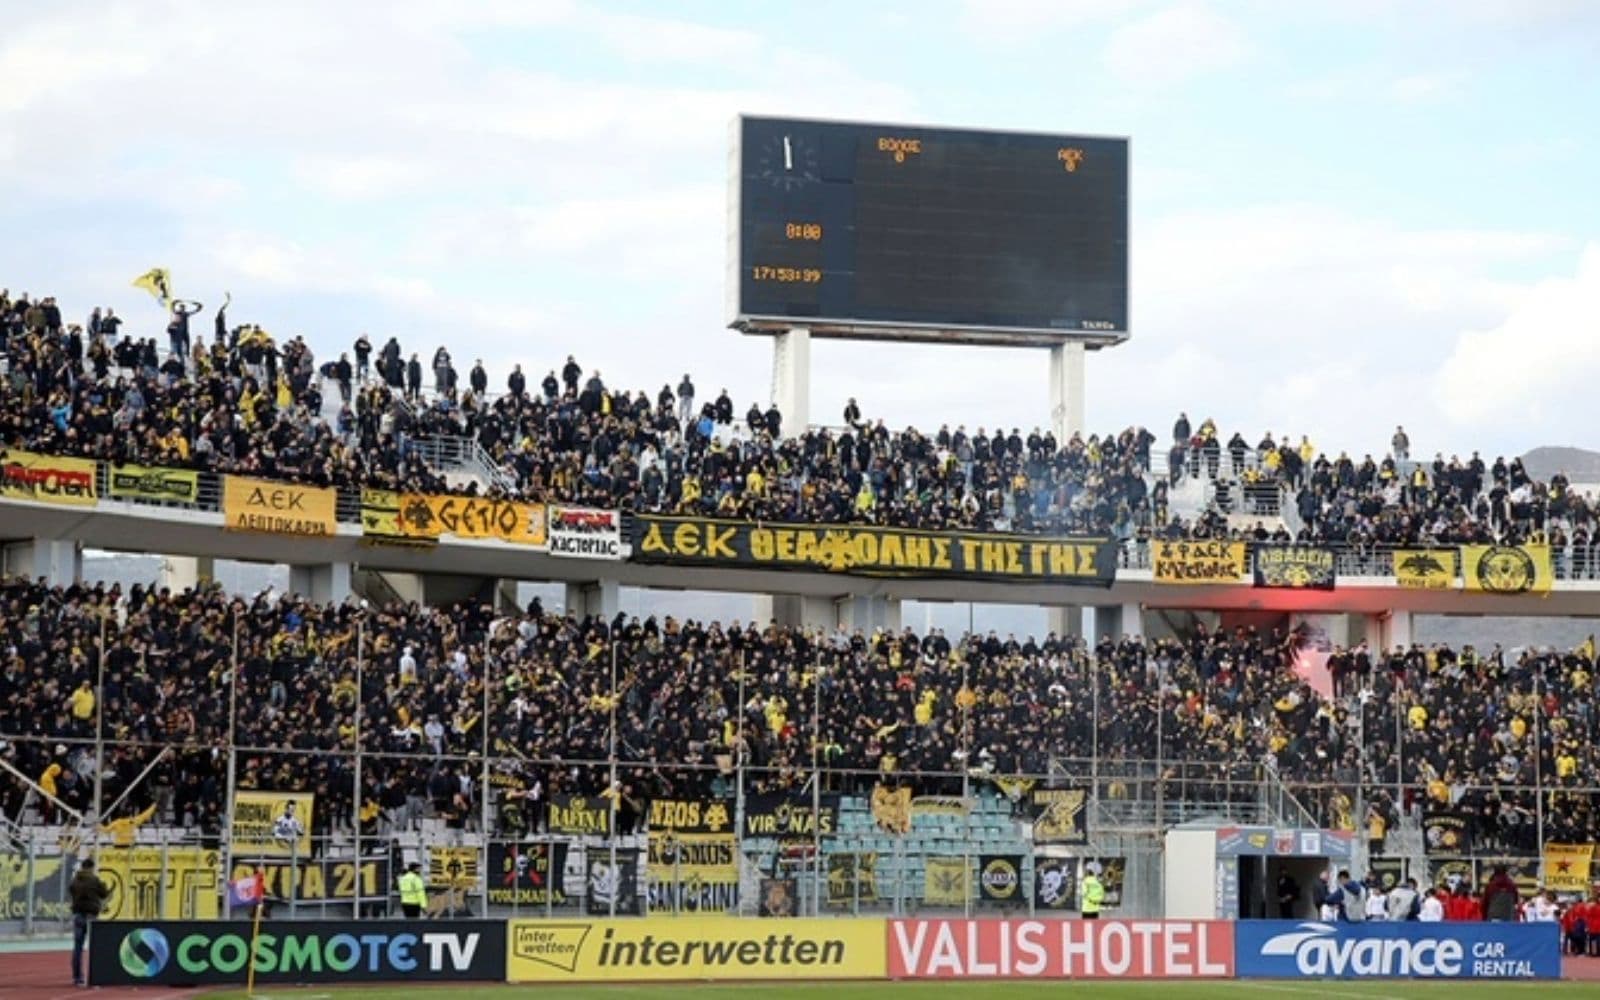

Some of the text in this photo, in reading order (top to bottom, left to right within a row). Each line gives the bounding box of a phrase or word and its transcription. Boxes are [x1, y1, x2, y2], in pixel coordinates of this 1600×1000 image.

[650, 800, 700, 827] NEOS
[333, 863, 377, 897] 21
[519, 926, 555, 942] inter
[598, 928, 845, 966] interwetten
[894, 921, 1226, 976] VALIS HOTEL
[1296, 937, 1463, 976] avance
[1472, 942, 1505, 958] CAR
[1473, 960, 1535, 976] RENTAL
